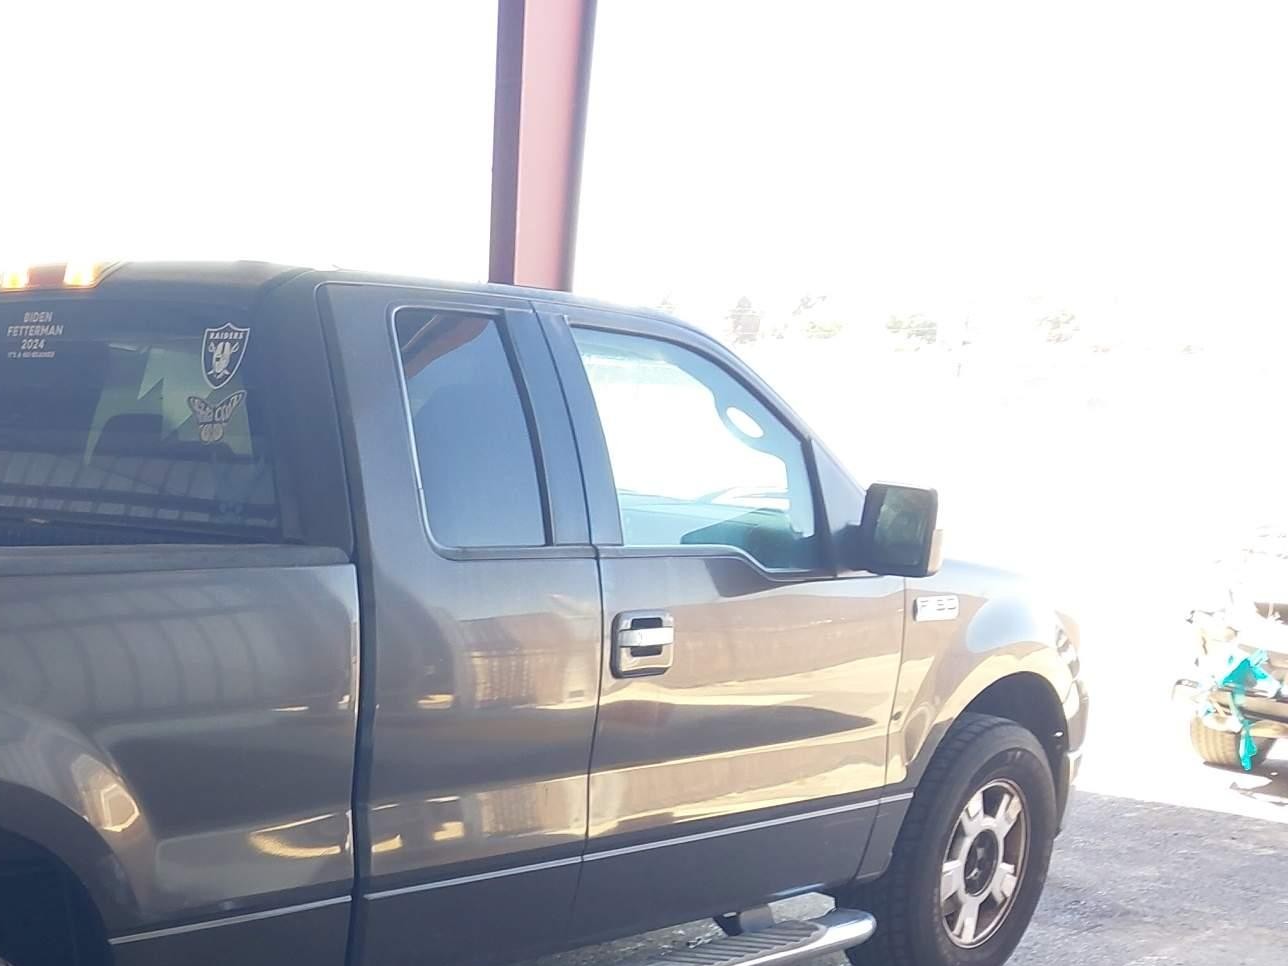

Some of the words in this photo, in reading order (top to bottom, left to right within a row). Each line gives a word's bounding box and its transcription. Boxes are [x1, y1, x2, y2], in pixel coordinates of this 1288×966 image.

[23, 311, 53, 323] BIDEN
[7, 325, 64, 337] FETTERMAN
[209, 331, 244, 340] RAIDERS
[21, 338, 46, 350] 2024
